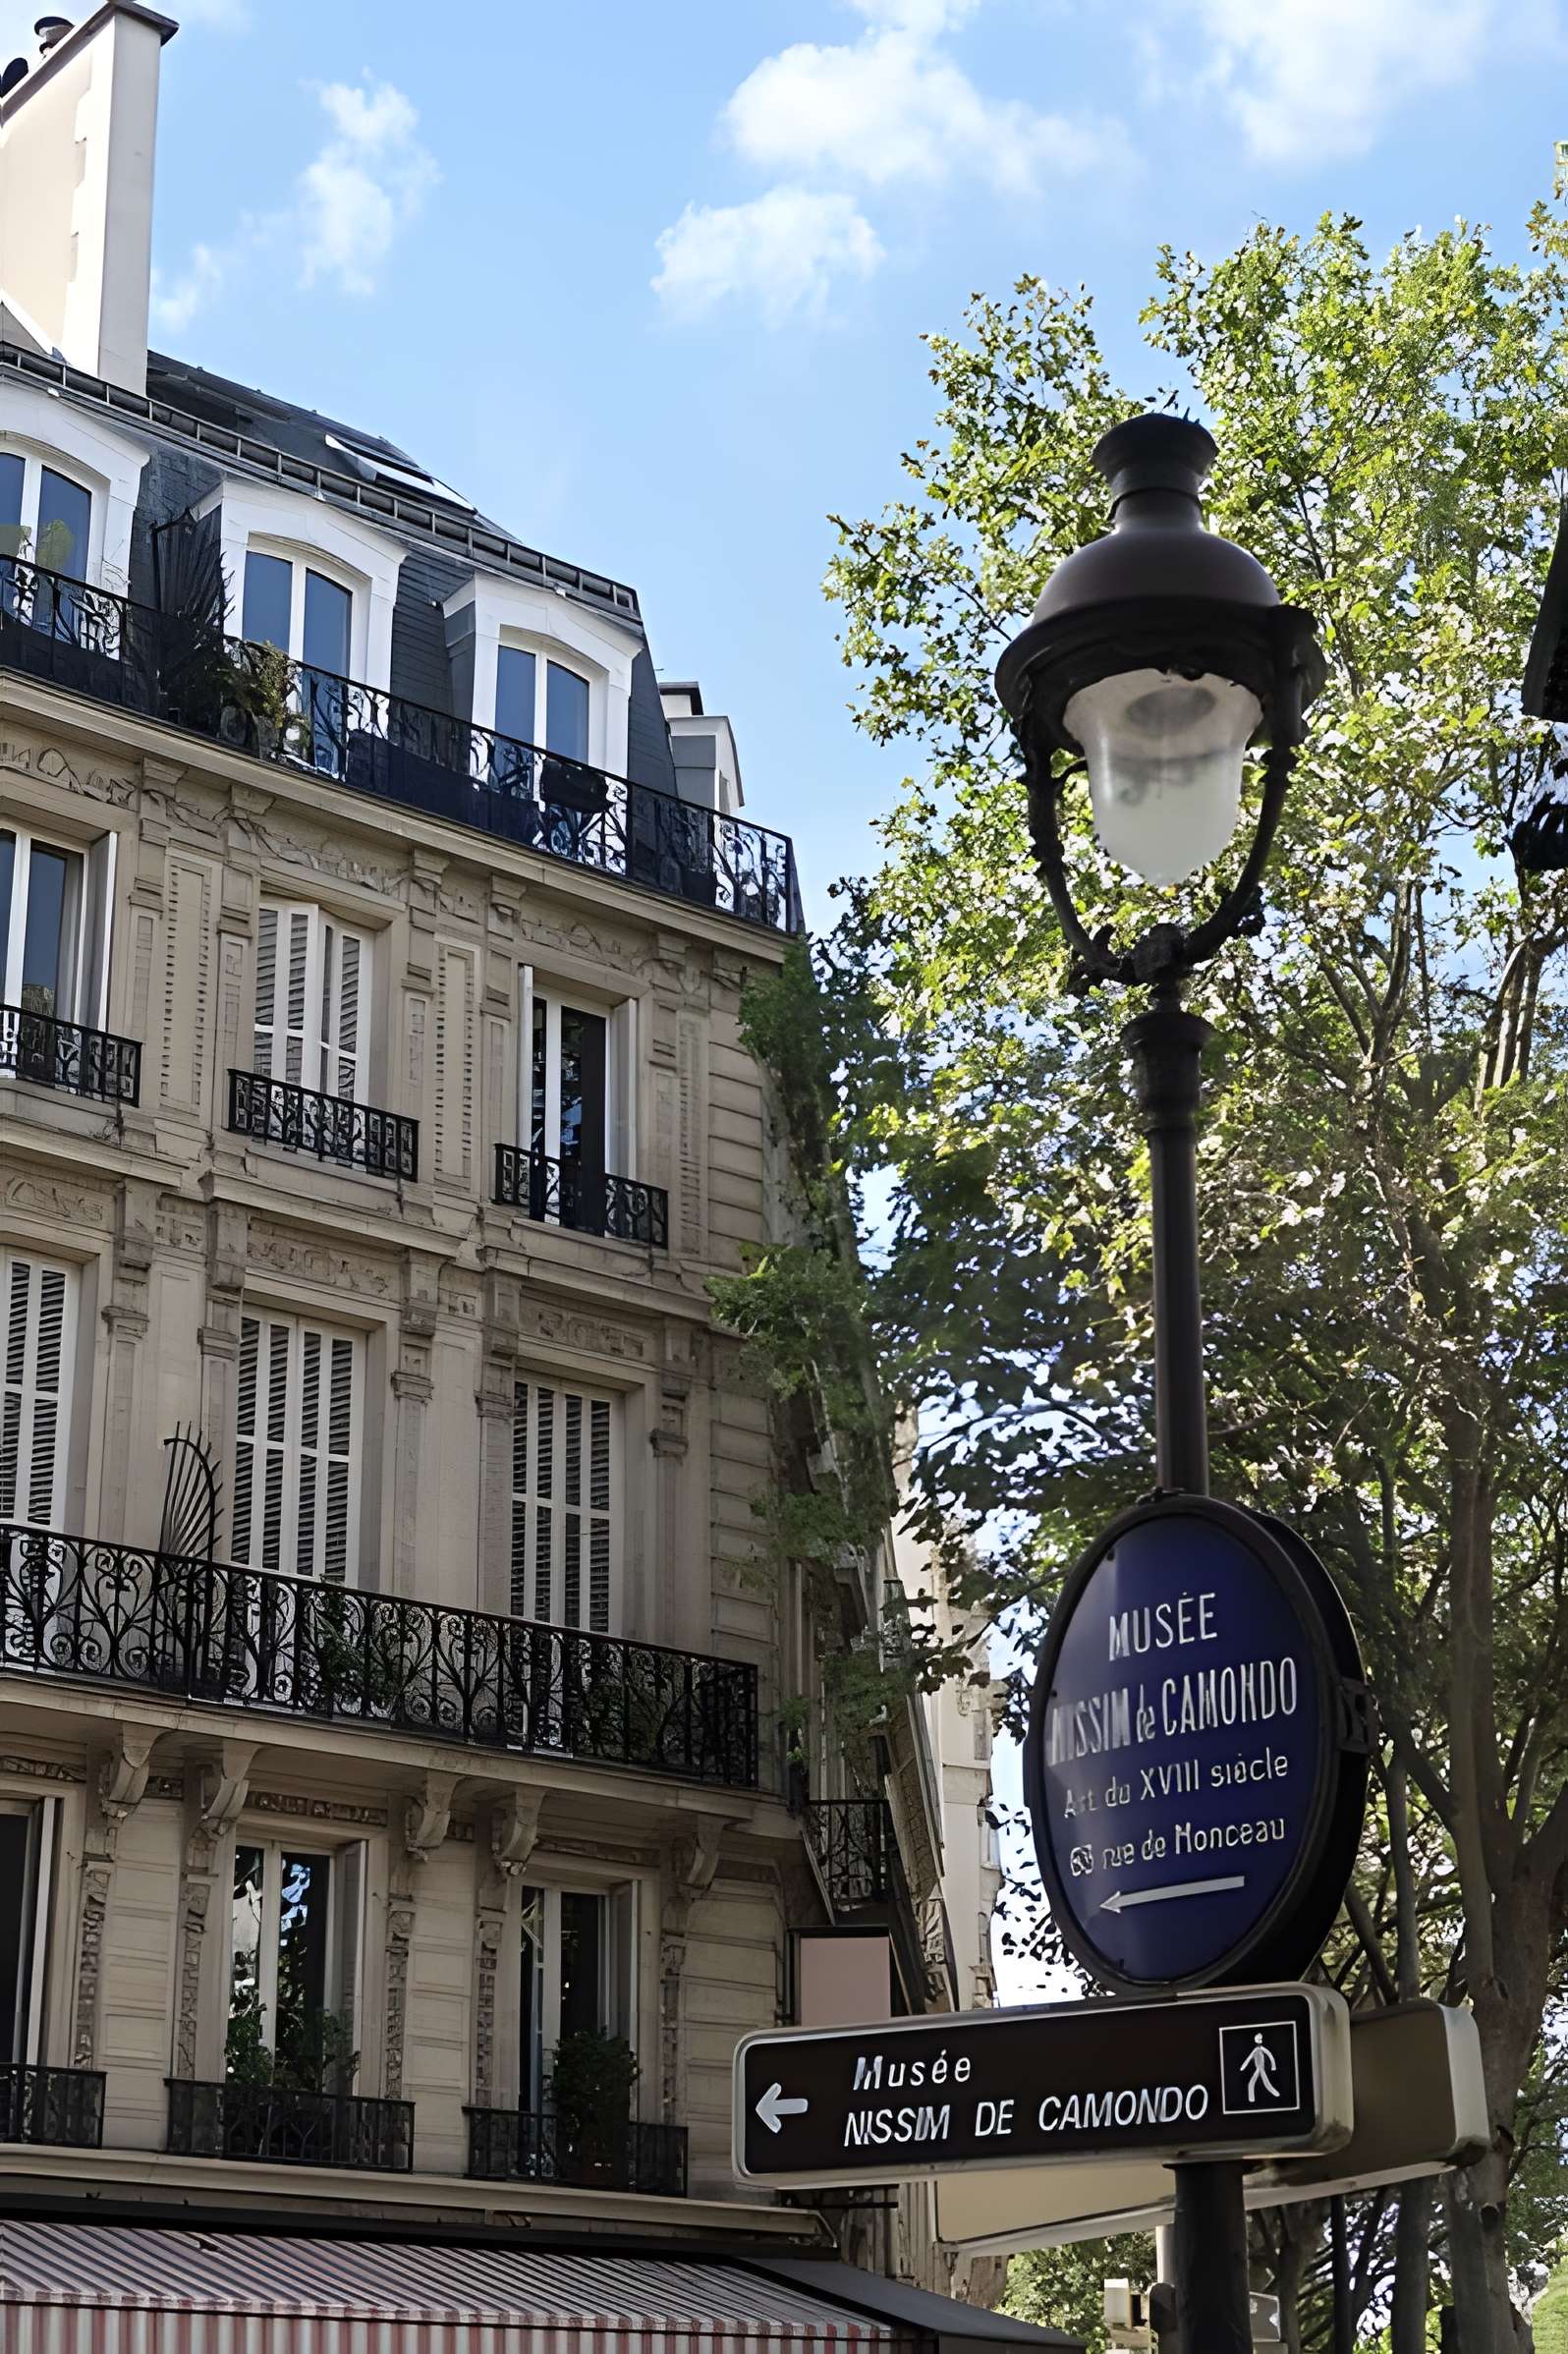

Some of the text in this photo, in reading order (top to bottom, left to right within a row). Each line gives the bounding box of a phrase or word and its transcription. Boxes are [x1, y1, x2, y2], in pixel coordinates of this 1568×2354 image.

[1108, 1591, 1217, 1661] MUSÉE
[1136, 1683, 1155, 1744] de
[1161, 1656, 1297, 1736] CAMONDO
[1104, 1775, 1131, 1807] du
[1140, 1759, 1200, 1800] XVIII
[1102, 1843, 1135, 1870] rue
[1142, 1828, 1167, 1861] de
[1174, 1818, 1285, 1855] Monceau
[853, 2049, 972, 2091] Musée
[844, 2084, 1209, 2148] NISSIM DE CAMONDO
